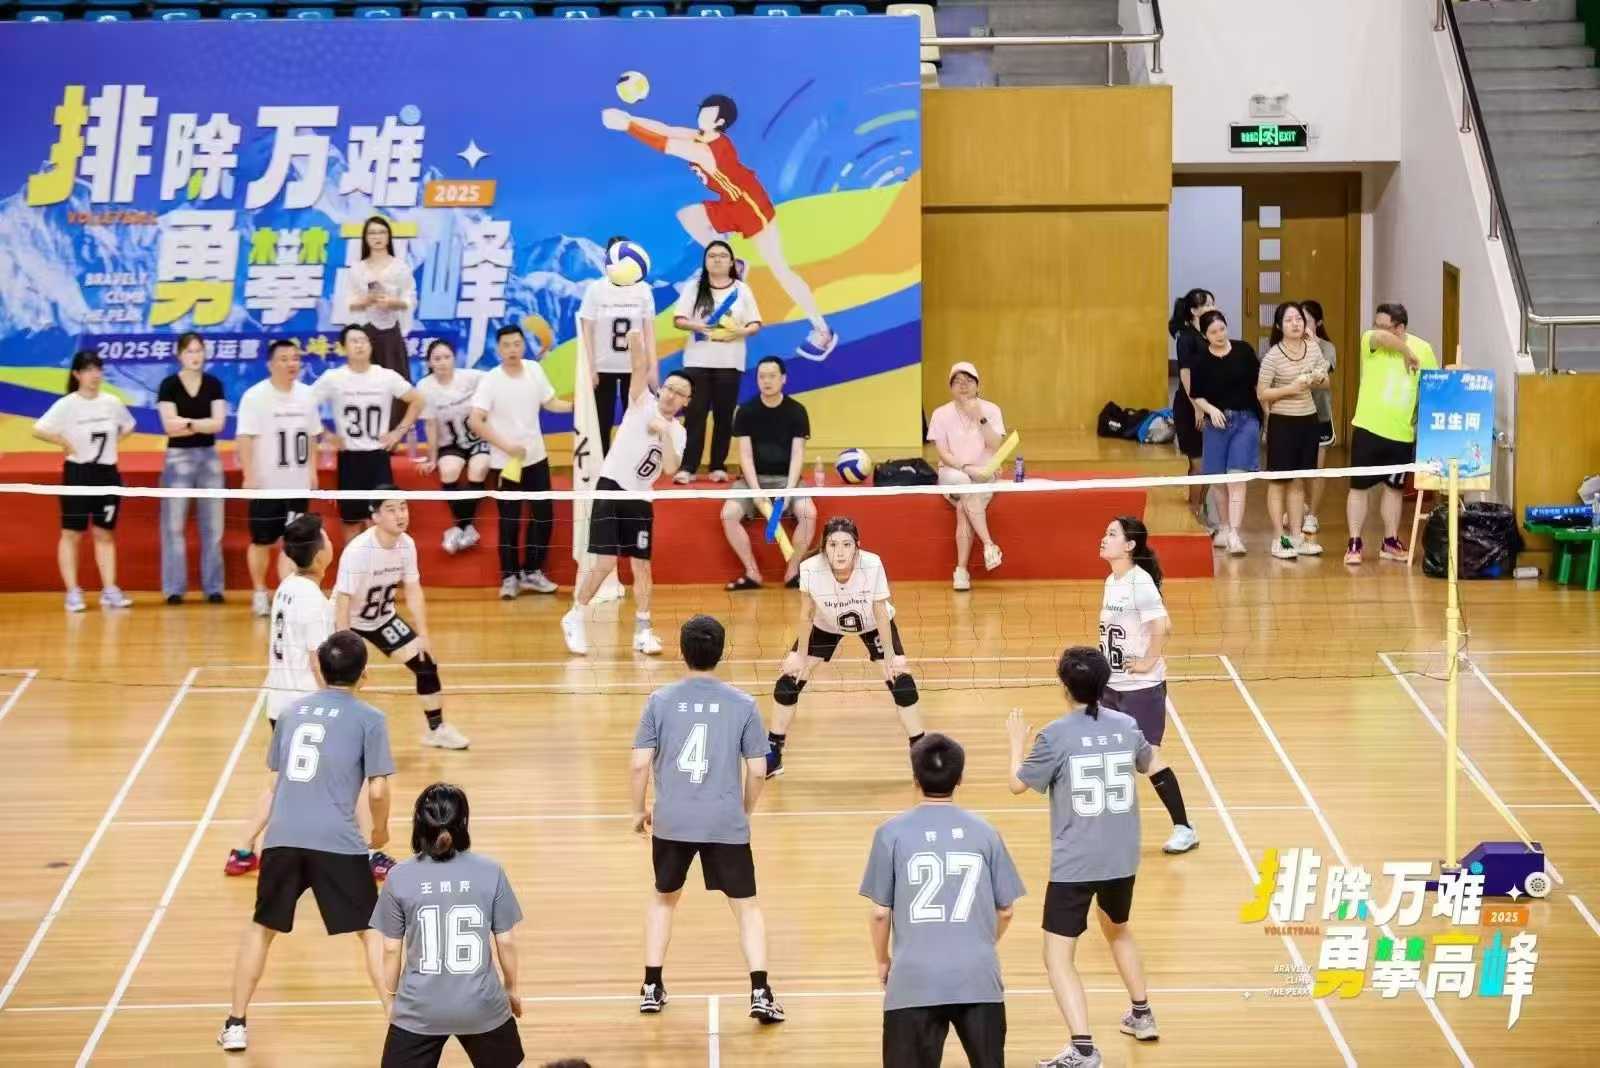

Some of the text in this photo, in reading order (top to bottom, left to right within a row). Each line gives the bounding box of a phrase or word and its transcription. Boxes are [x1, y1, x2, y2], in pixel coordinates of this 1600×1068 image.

[27, 84, 426, 209] 排除万难
[1279, 131, 1297, 142] EXIT
[432, 184, 481, 203] 2025
[611, 316, 632, 352] 8
[343, 404, 382, 441] 30
[1430, 412, 1481, 432] 卫生间
[90, 432, 107, 464] 7
[277, 430, 309, 467] 10
[634, 446, 662, 480] 6
[103, 505, 116, 523] 7
[636, 530, 649, 550] 6
[286, 723, 326, 782] 6
[676, 723, 708, 784] 4
[1069, 750, 1135, 817] 55
[907, 851, 983, 924] 27
[417, 904, 484, 975] 16
